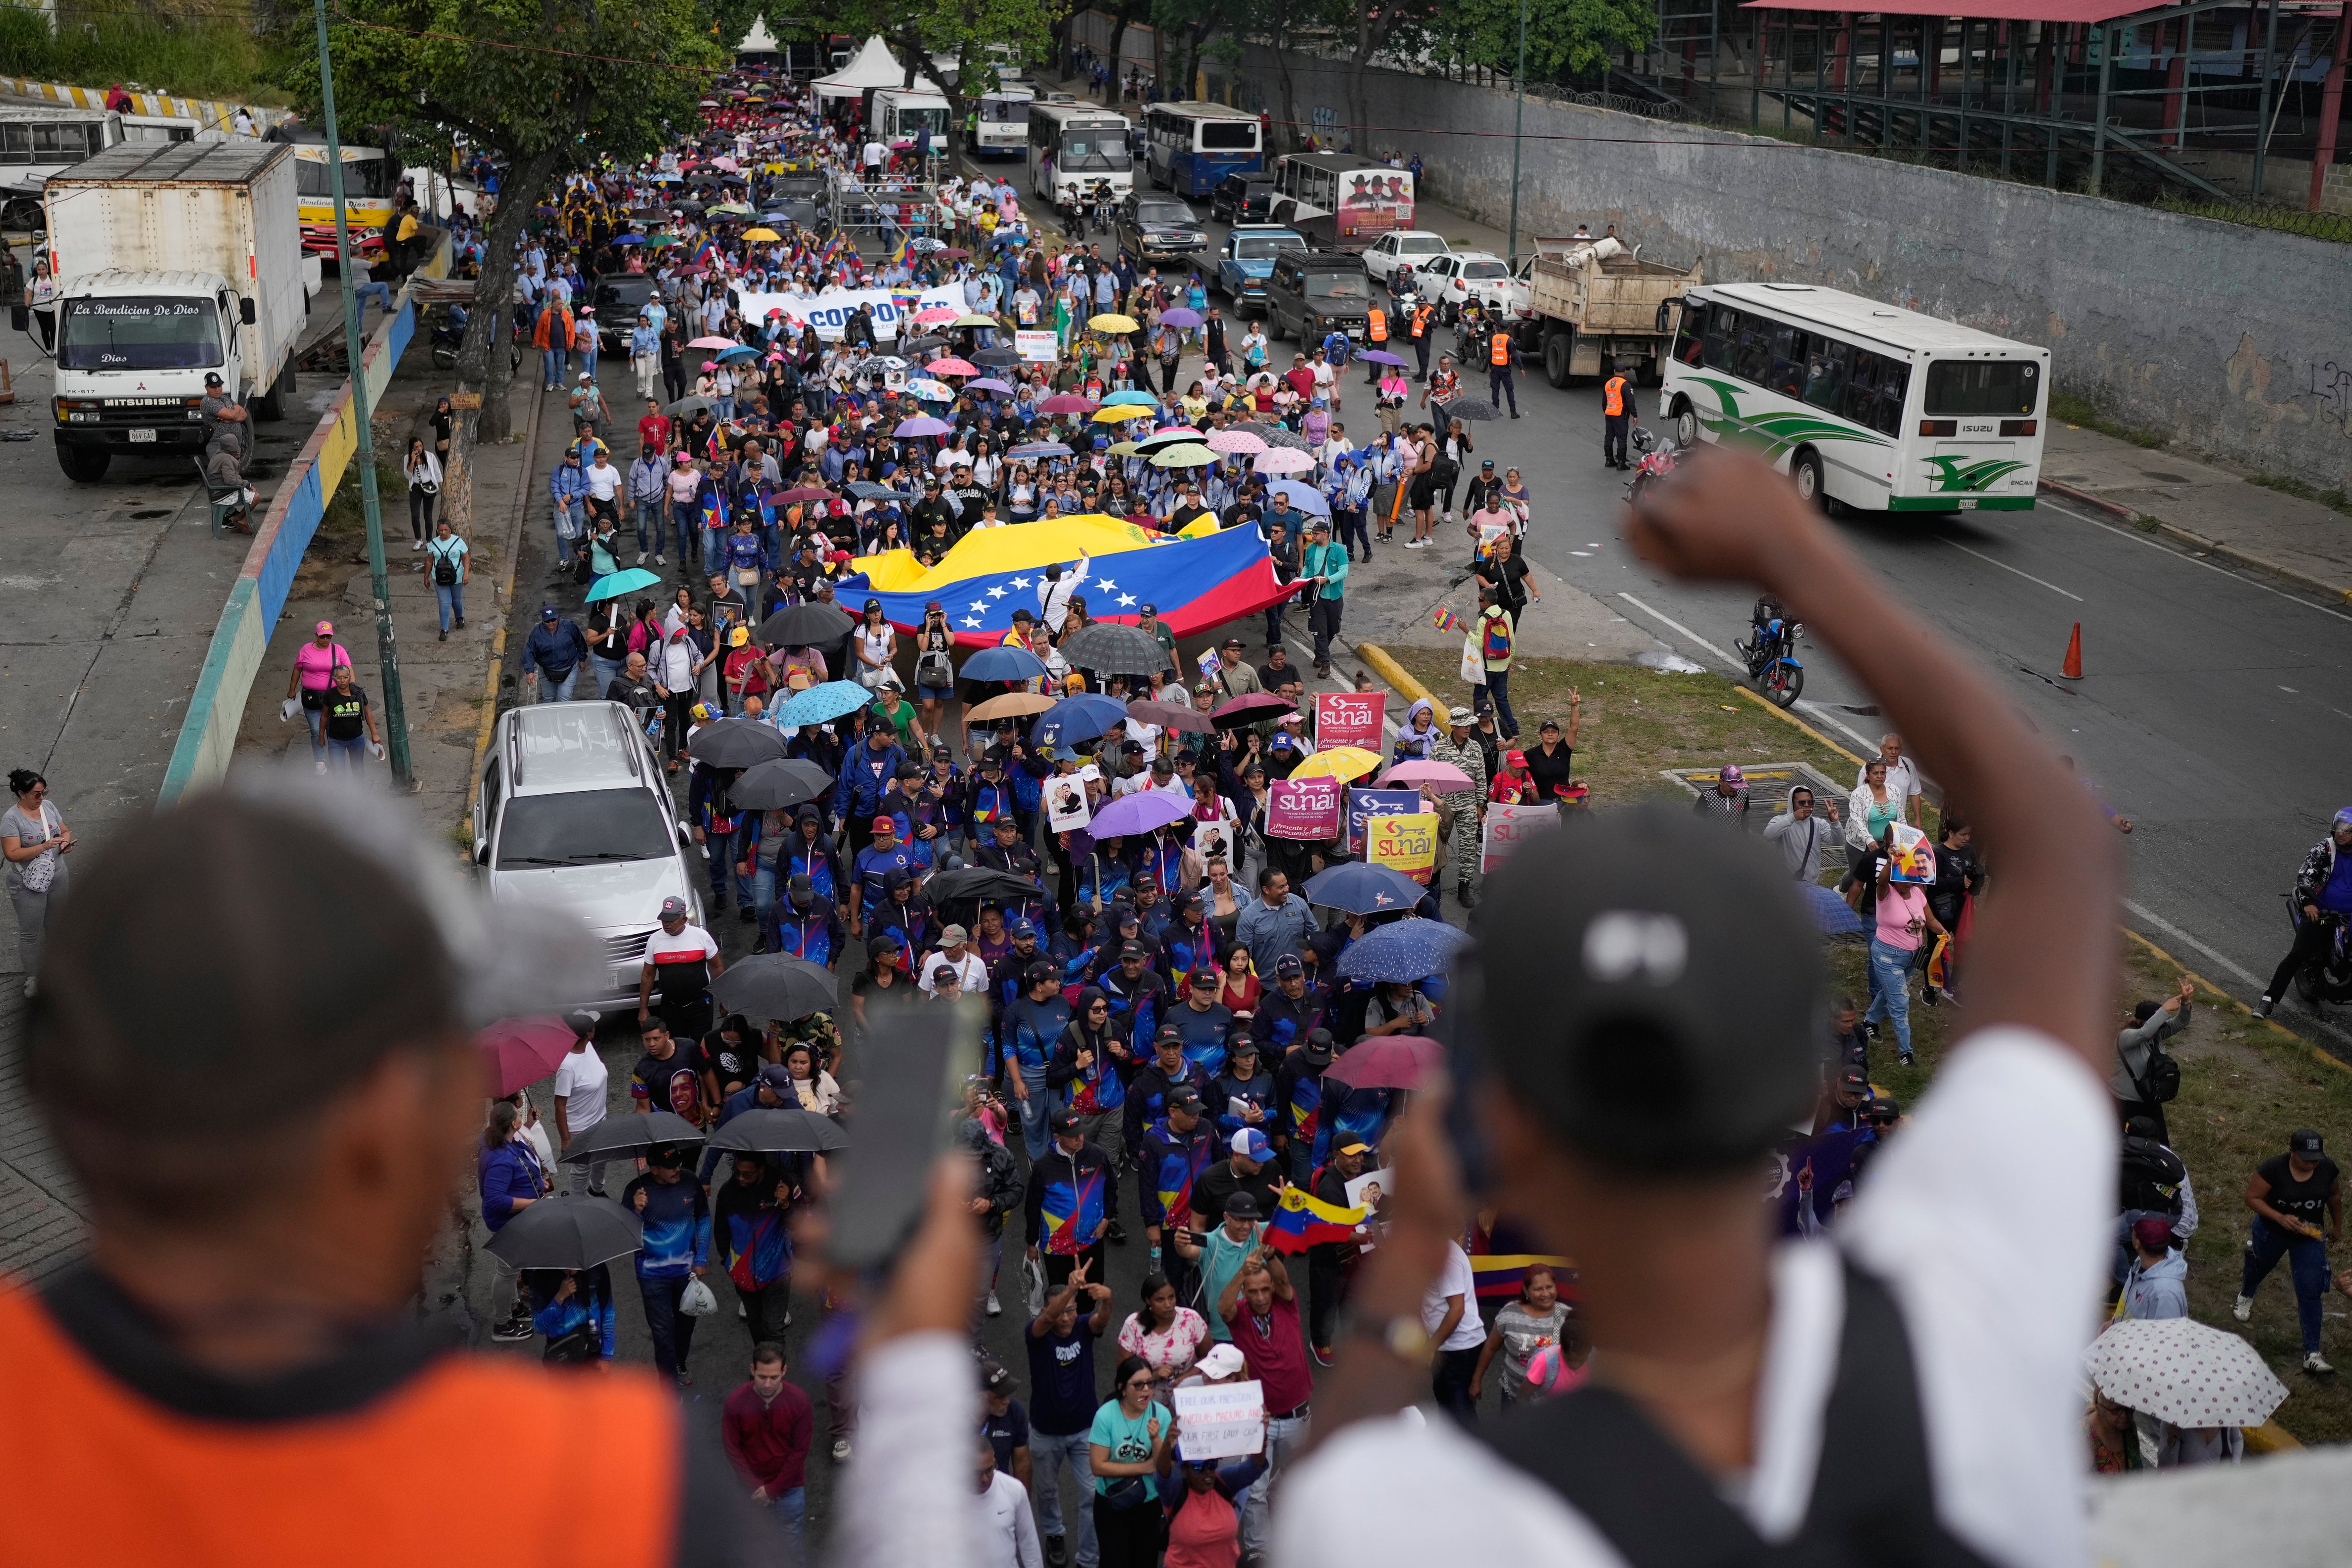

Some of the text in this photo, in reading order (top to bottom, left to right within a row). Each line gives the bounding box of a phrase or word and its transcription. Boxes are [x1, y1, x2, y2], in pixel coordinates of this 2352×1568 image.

[1357, 213, 1395, 225] BRUTOS
[74, 304, 199, 316] La Bendicion De Dios
[101, 353, 127, 363] Dios
[104, 398, 180, 406] MITSUBISHI
[345, 702, 360, 712] 19
[1053, 812, 1087, 822] #LOSQUEREMOSDEVUELTA
[1270, 828, 1312, 836] Consecuente!
[1180, 1396, 1197, 1407] FREE
[1183, 1409, 1261, 1425] NICOLAS MADURO AND
[1183, 1431, 1198, 1442] OUR
[1202, 1430, 1219, 1441] FIRST
[1223, 1428, 1238, 1439] LADY
